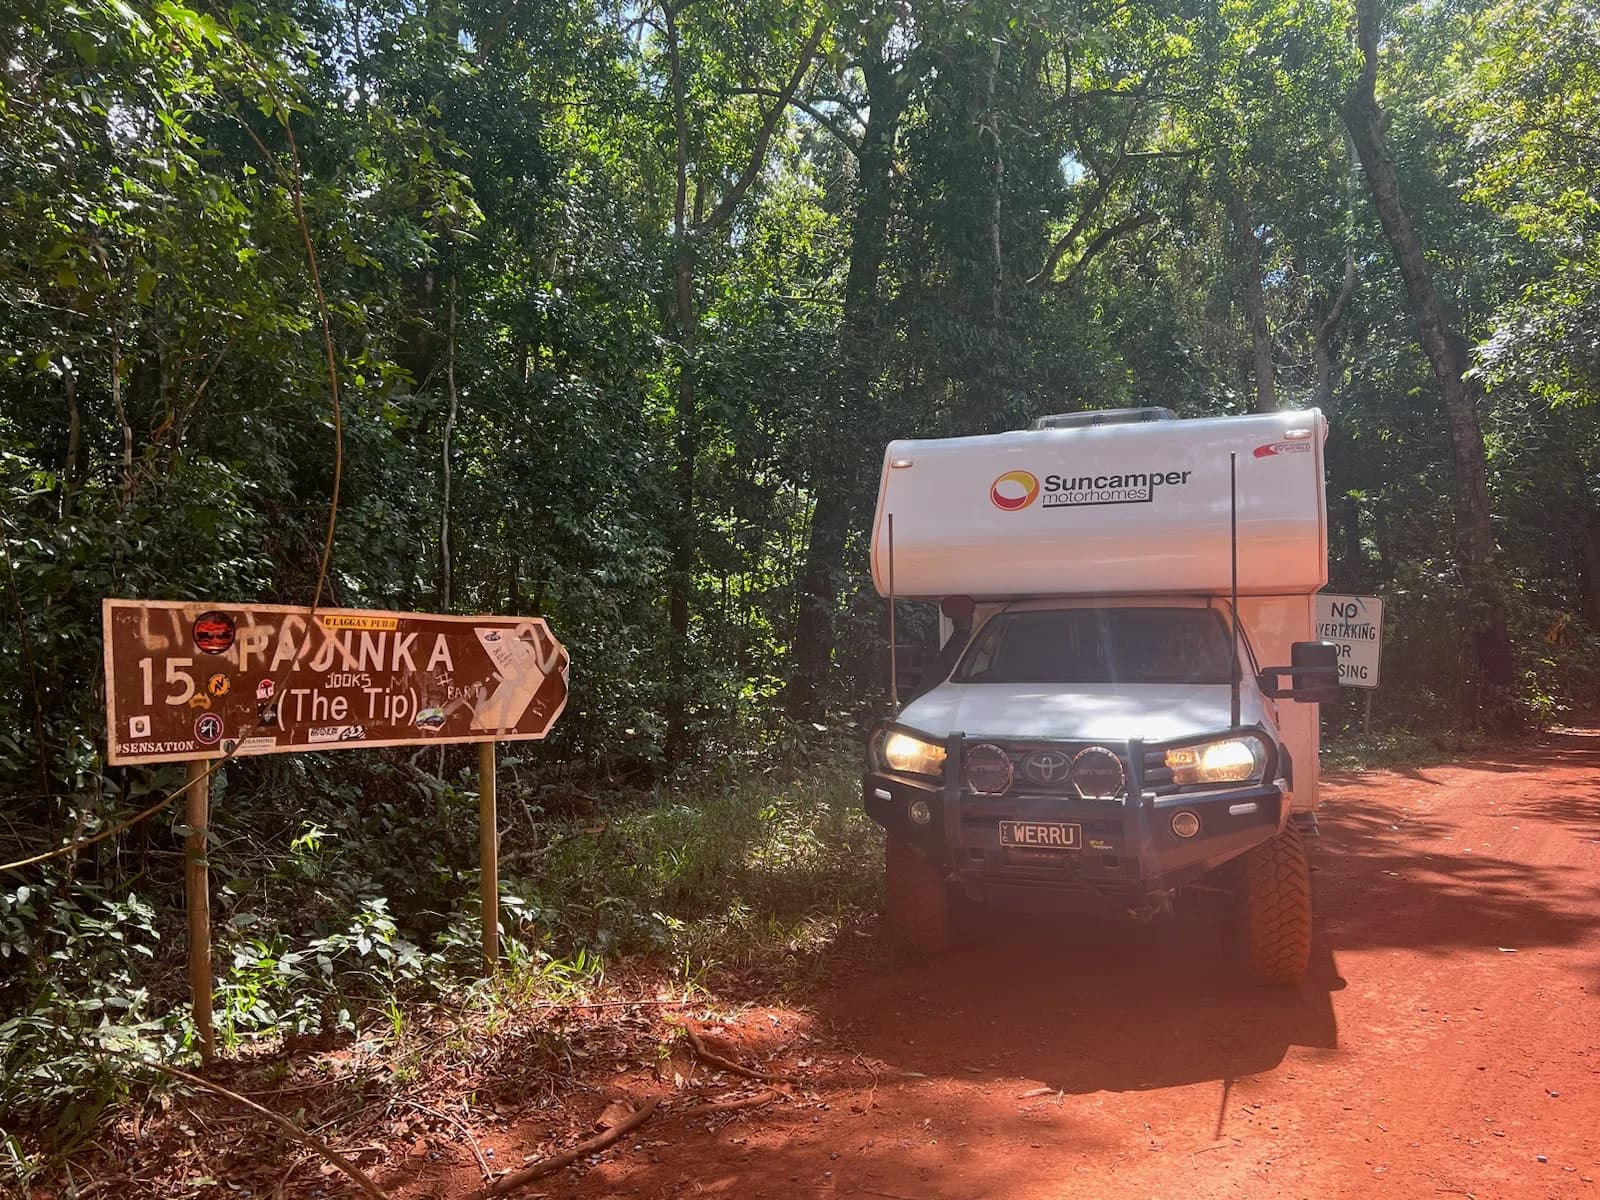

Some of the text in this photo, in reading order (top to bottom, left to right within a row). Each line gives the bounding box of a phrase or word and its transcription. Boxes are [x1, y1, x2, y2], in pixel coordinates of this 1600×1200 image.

[1044, 471, 1192, 500] Suncamper
[1042, 487, 1147, 504] motorhomes
[1331, 602, 1358, 619] NO
[1316, 623, 1376, 640] VERTAKING
[239, 628, 455, 673] PAJINKA
[1338, 663, 1368, 679] SING
[139, 657, 196, 707] 15
[447, 681, 483, 700] BART
[277, 687, 418, 732] (The Tip)
[1013, 825, 1074, 845] WERRU
